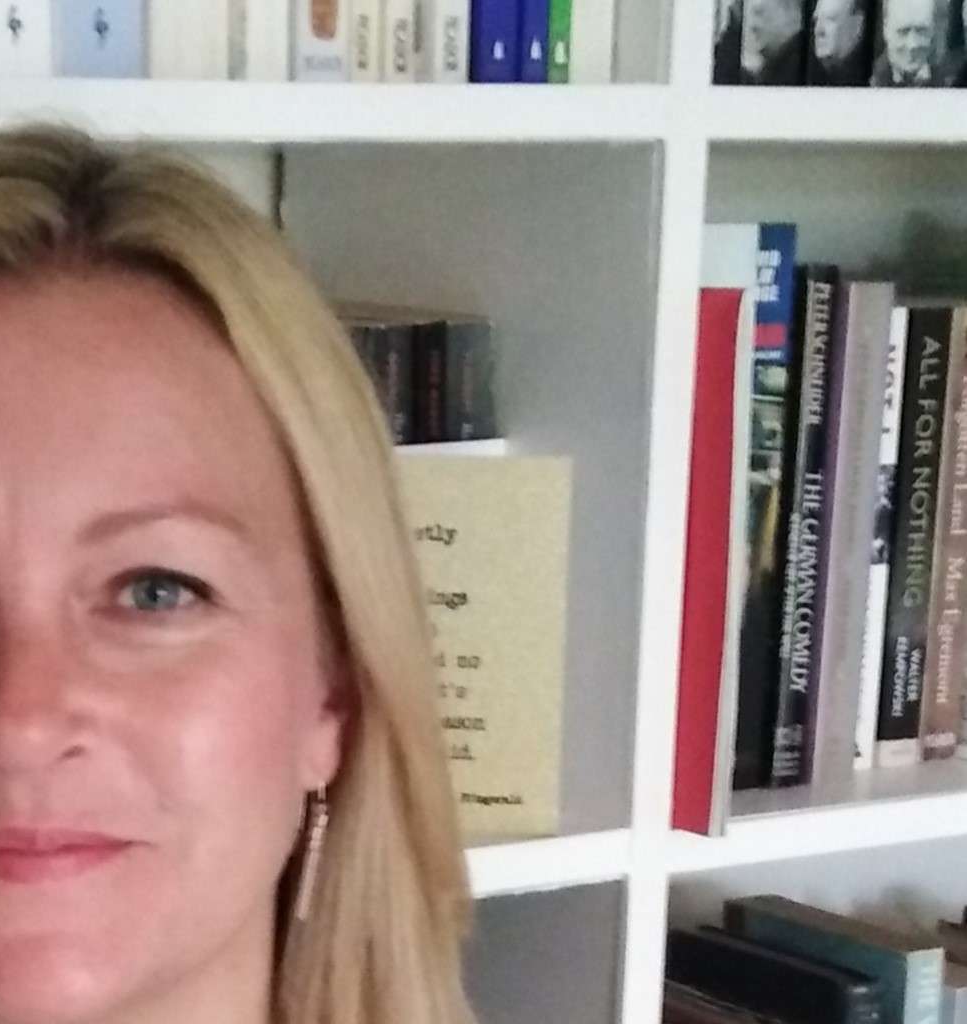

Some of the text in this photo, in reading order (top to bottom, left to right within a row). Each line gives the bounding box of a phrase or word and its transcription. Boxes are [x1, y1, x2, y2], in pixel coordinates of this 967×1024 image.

[813, 281, 832, 334] PETER
[903, 335, 942, 608] ALL FOR NOTHING
[788, 470, 824, 694] THE GERMAN COMEDY
[945, 556, 966, 604] Max
[456, 654, 481, 669] no
[906, 647, 923, 702] WALTER
[936, 609, 961, 705] Egremont
